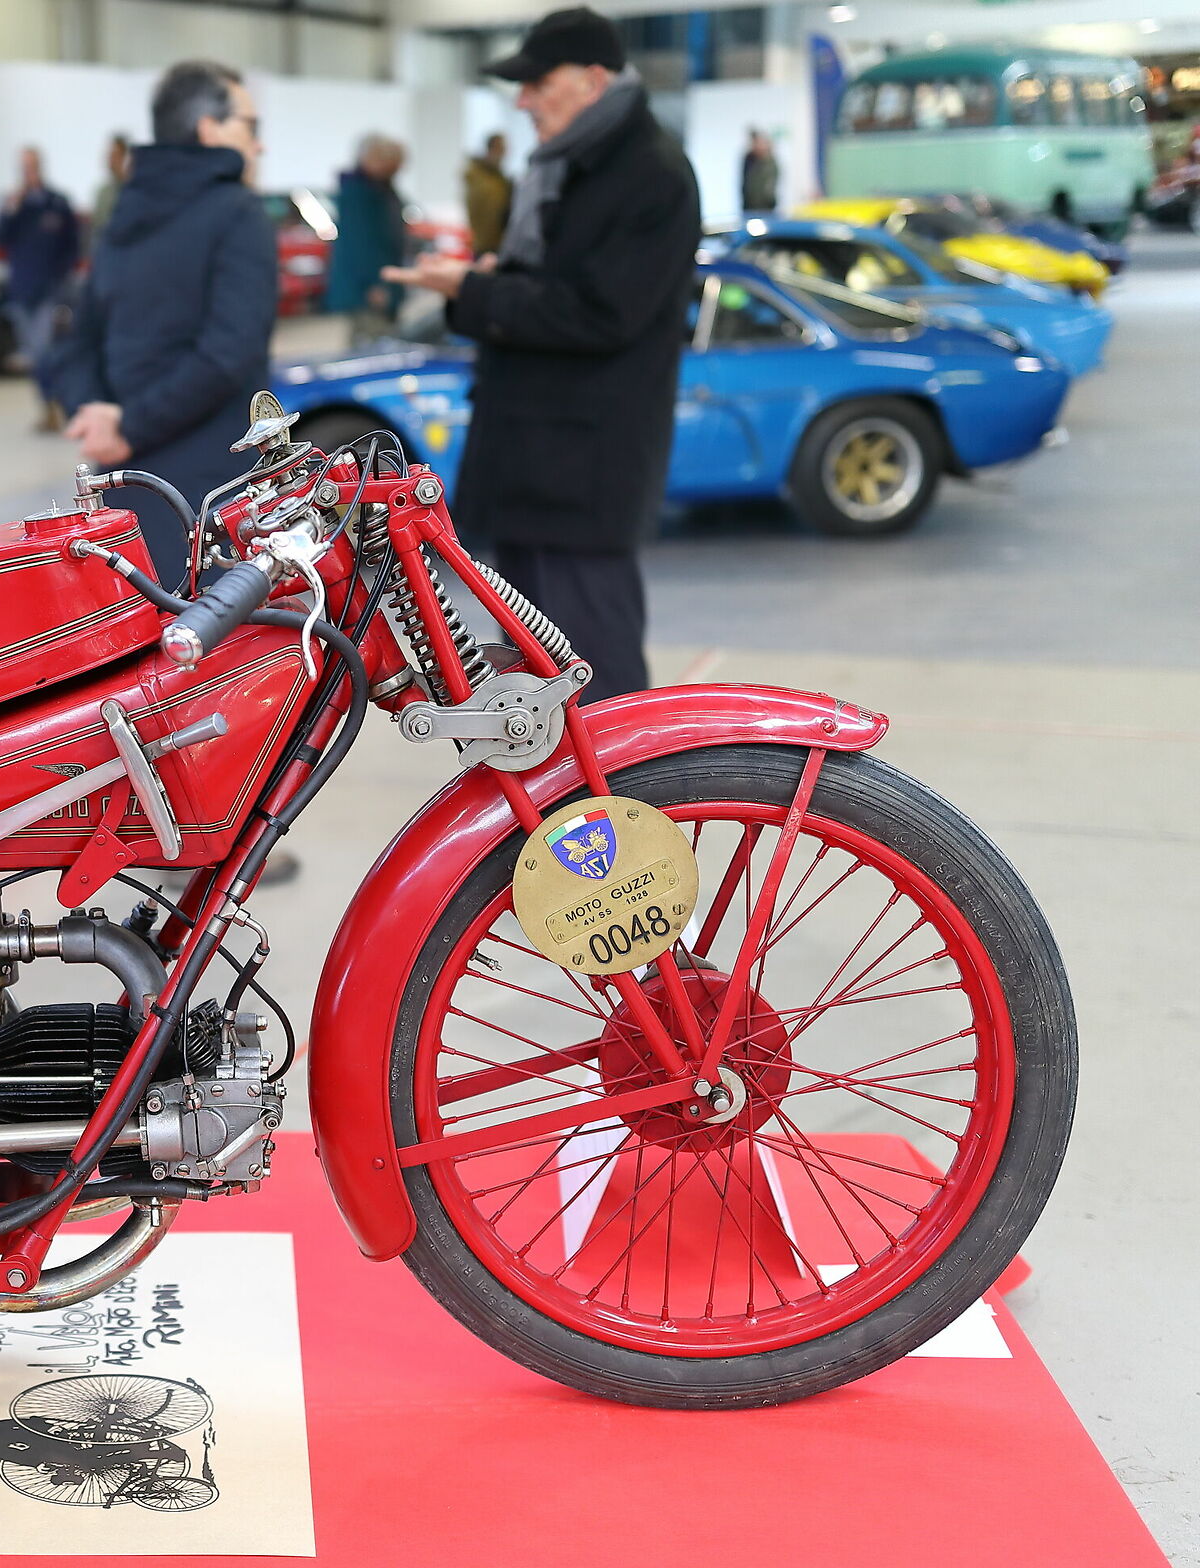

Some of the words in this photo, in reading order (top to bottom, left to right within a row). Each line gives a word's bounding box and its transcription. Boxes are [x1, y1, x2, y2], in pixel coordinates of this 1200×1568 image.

[580, 853, 610, 879] ASI
[565, 898, 602, 923] MOTO
[610, 871, 656, 900] GUZZI
[625, 889, 649, 905] 1928
[589, 905, 671, 965] 0048
